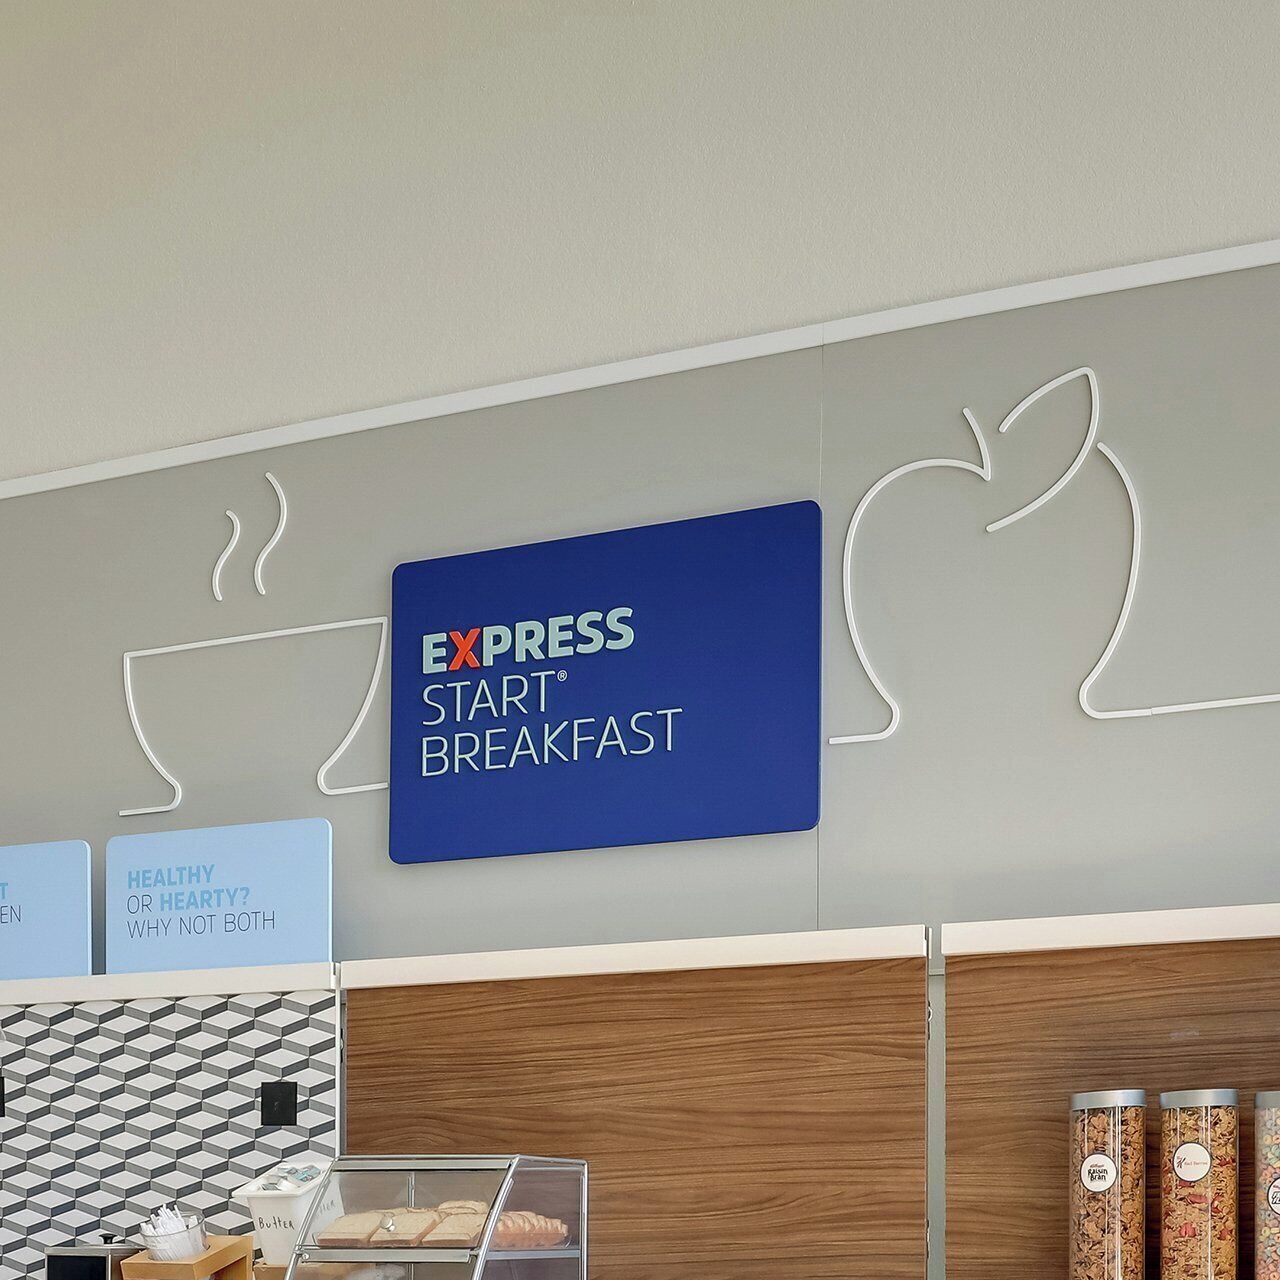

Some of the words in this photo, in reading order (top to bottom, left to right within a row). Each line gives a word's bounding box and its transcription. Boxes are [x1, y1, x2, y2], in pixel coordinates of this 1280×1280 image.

[422, 606, 635, 674] EXPRESS
[422, 707, 683, 777] BREAKFAST
[127, 864, 215, 889] HEALTHY
[126, 894, 152, 914] OR
[160, 886, 250, 911] HEARTY?
[126, 918, 172, 939] WHY
[179, 914, 216, 935] NOT
[224, 910, 275, 933] BOTH
